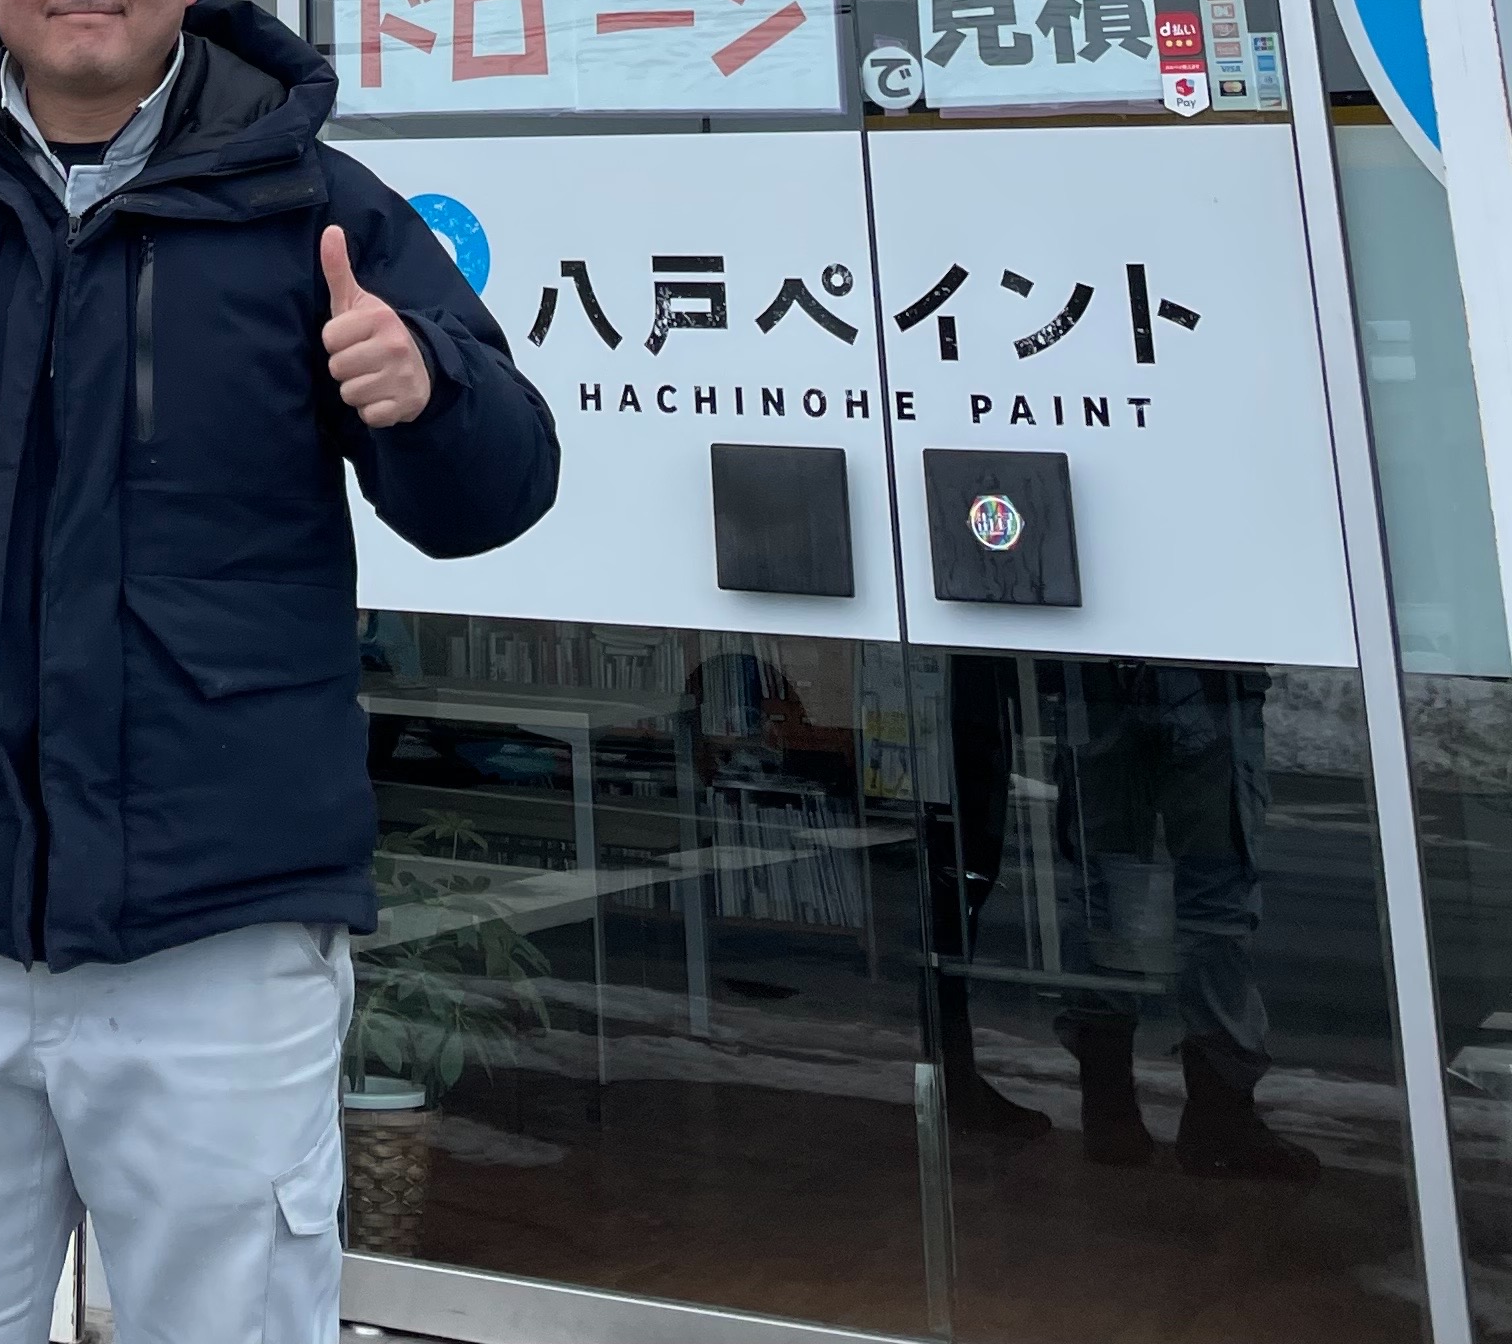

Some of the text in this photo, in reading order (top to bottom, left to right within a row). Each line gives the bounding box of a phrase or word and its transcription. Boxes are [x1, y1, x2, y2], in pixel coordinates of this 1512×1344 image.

[1159, 21, 1197, 37] d払い
[870, 58, 912, 98] で
[1177, 97, 1196, 110] Pay
[527, 254, 1202, 365] 八戸ペイント
[579, 382, 1155, 430] HACHINOHE PAINT
